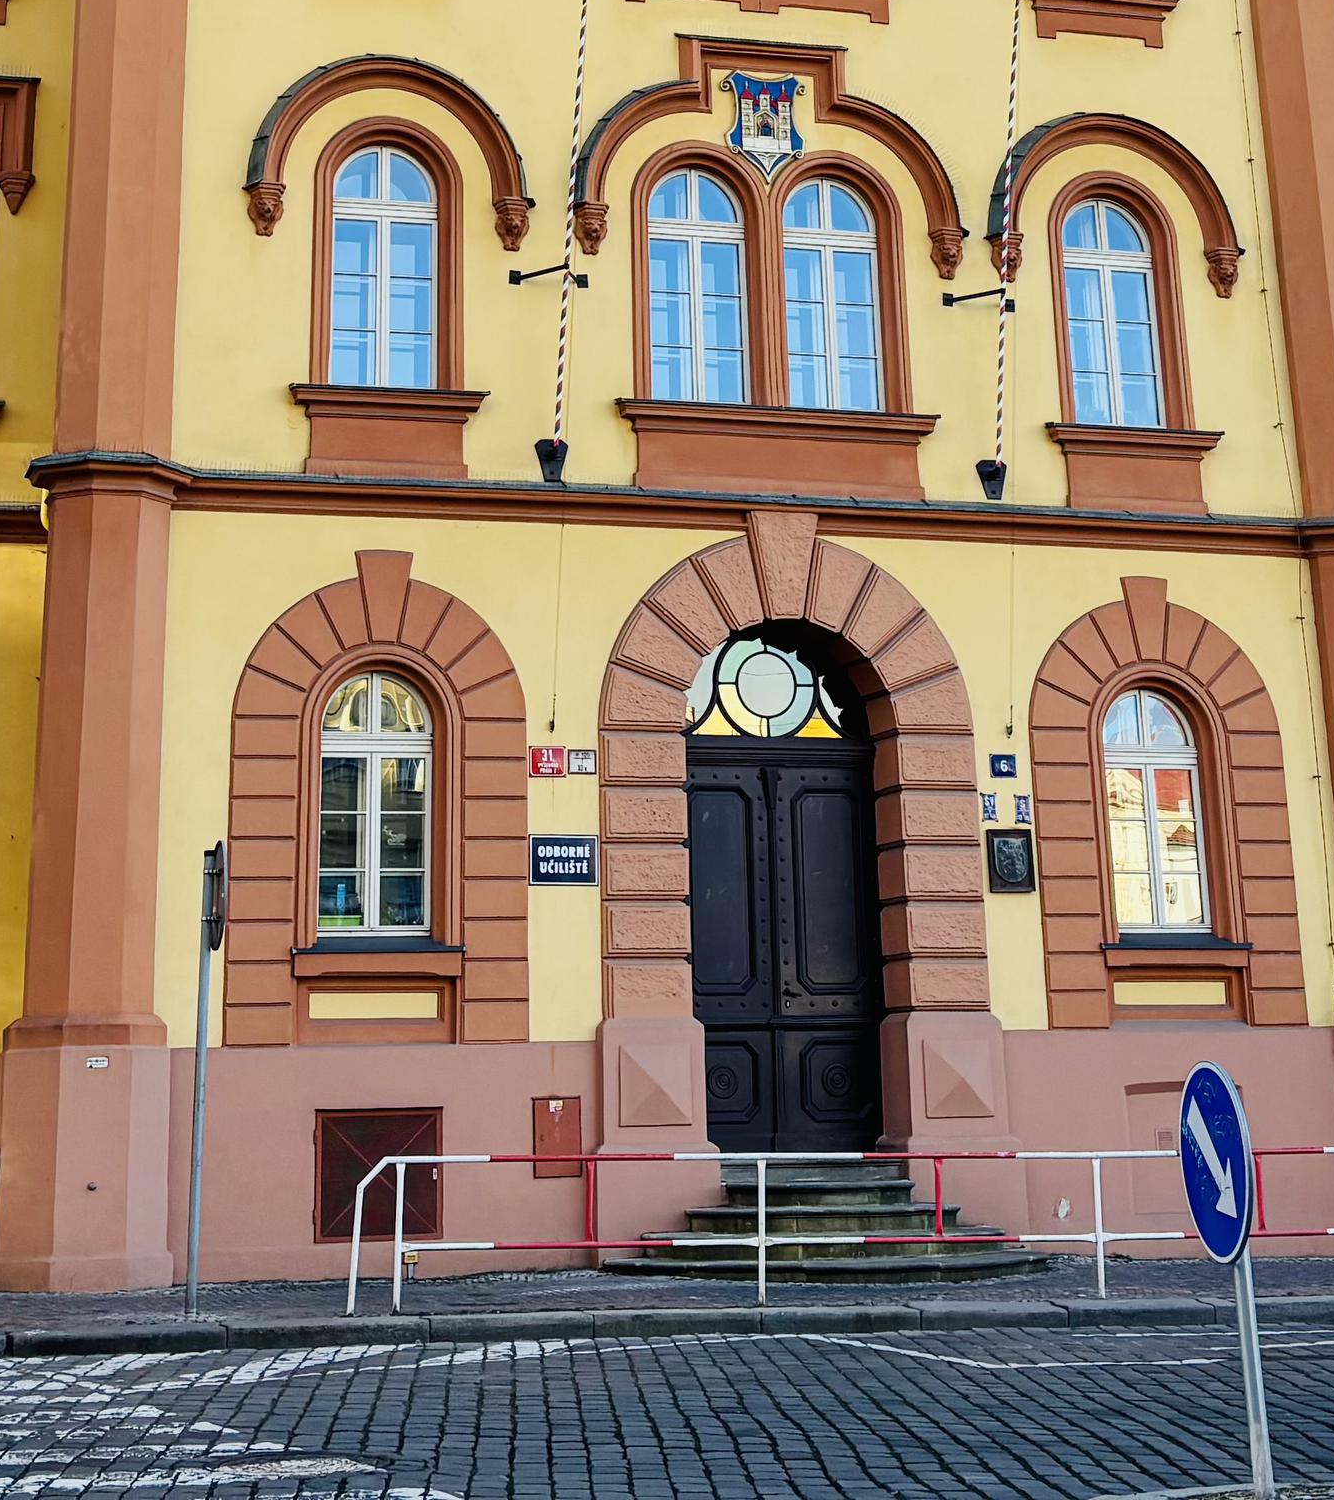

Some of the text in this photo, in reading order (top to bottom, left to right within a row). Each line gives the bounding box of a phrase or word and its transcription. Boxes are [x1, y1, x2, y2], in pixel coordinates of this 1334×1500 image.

[1000, 759, 1009, 772] 6
[537, 844, 591, 858] ODBORNÉ
[539, 859, 588, 874] UČILIŠTĚ
